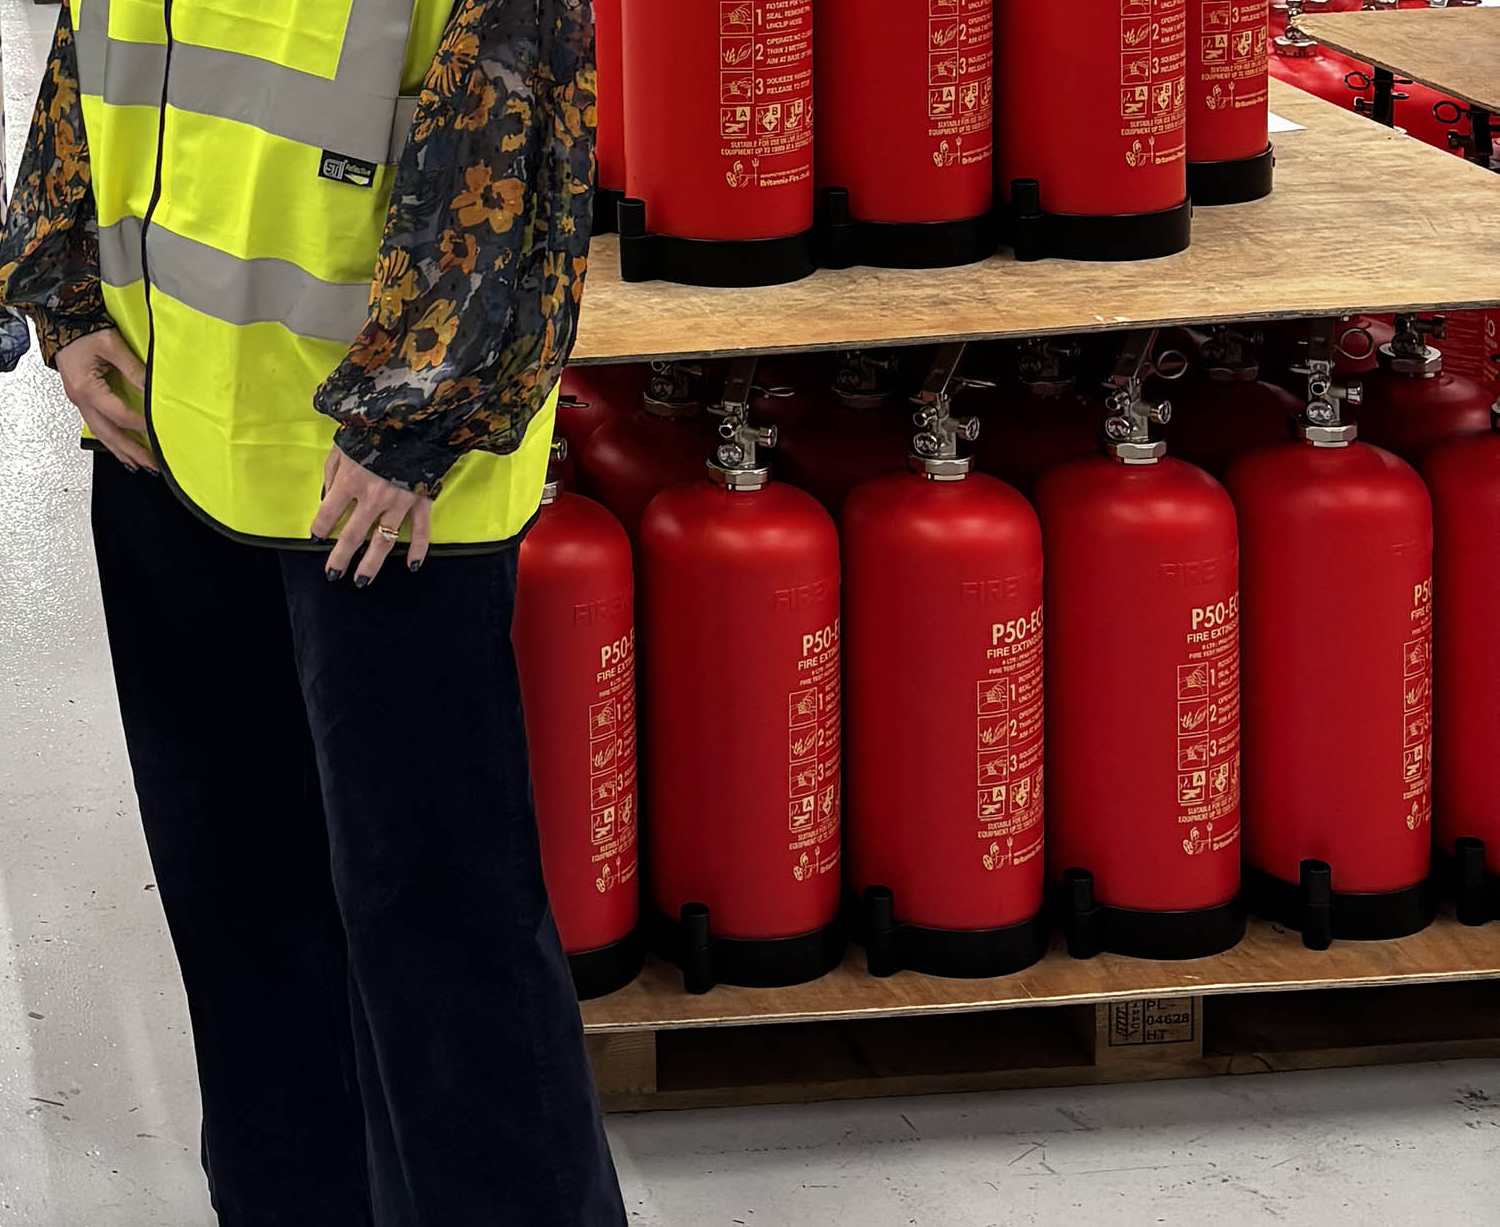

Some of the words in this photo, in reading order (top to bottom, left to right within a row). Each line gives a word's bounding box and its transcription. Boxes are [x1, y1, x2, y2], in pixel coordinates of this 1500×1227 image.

[756, 9, 762, 26] 1
[1232, 7, 1239, 23] 3
[959, 24, 967, 41] 2
[1152, 23, 1159, 40] 2
[755, 44, 764, 61] 2
[959, 57, 966, 75] 3
[1152, 57, 1159, 74] 3
[756, 78, 764, 95] 3
[1191, 591, 1239, 630] P50-EC
[992, 605, 1043, 645] P50-EC
[803, 619, 840, 656] P50-E
[1187, 631, 1209, 643] FIRE
[601, 627, 635, 668] P50-E
[987, 647, 1009, 659] FIRE
[798, 657, 818, 671] FIRE
[597, 667, 616, 683] FIRE
[1210, 668, 1215, 686] 1
[1010, 684, 1016, 701] 1
[1210, 704, 1216, 722] 2
[1010, 719, 1017, 736] 2
[818, 728, 824, 747] 2
[1210, 740, 1217, 757] 3
[1010, 755, 1017, 772] 3
[818, 764, 824, 781] 3
[1147, 1029, 1165, 1040] HT
